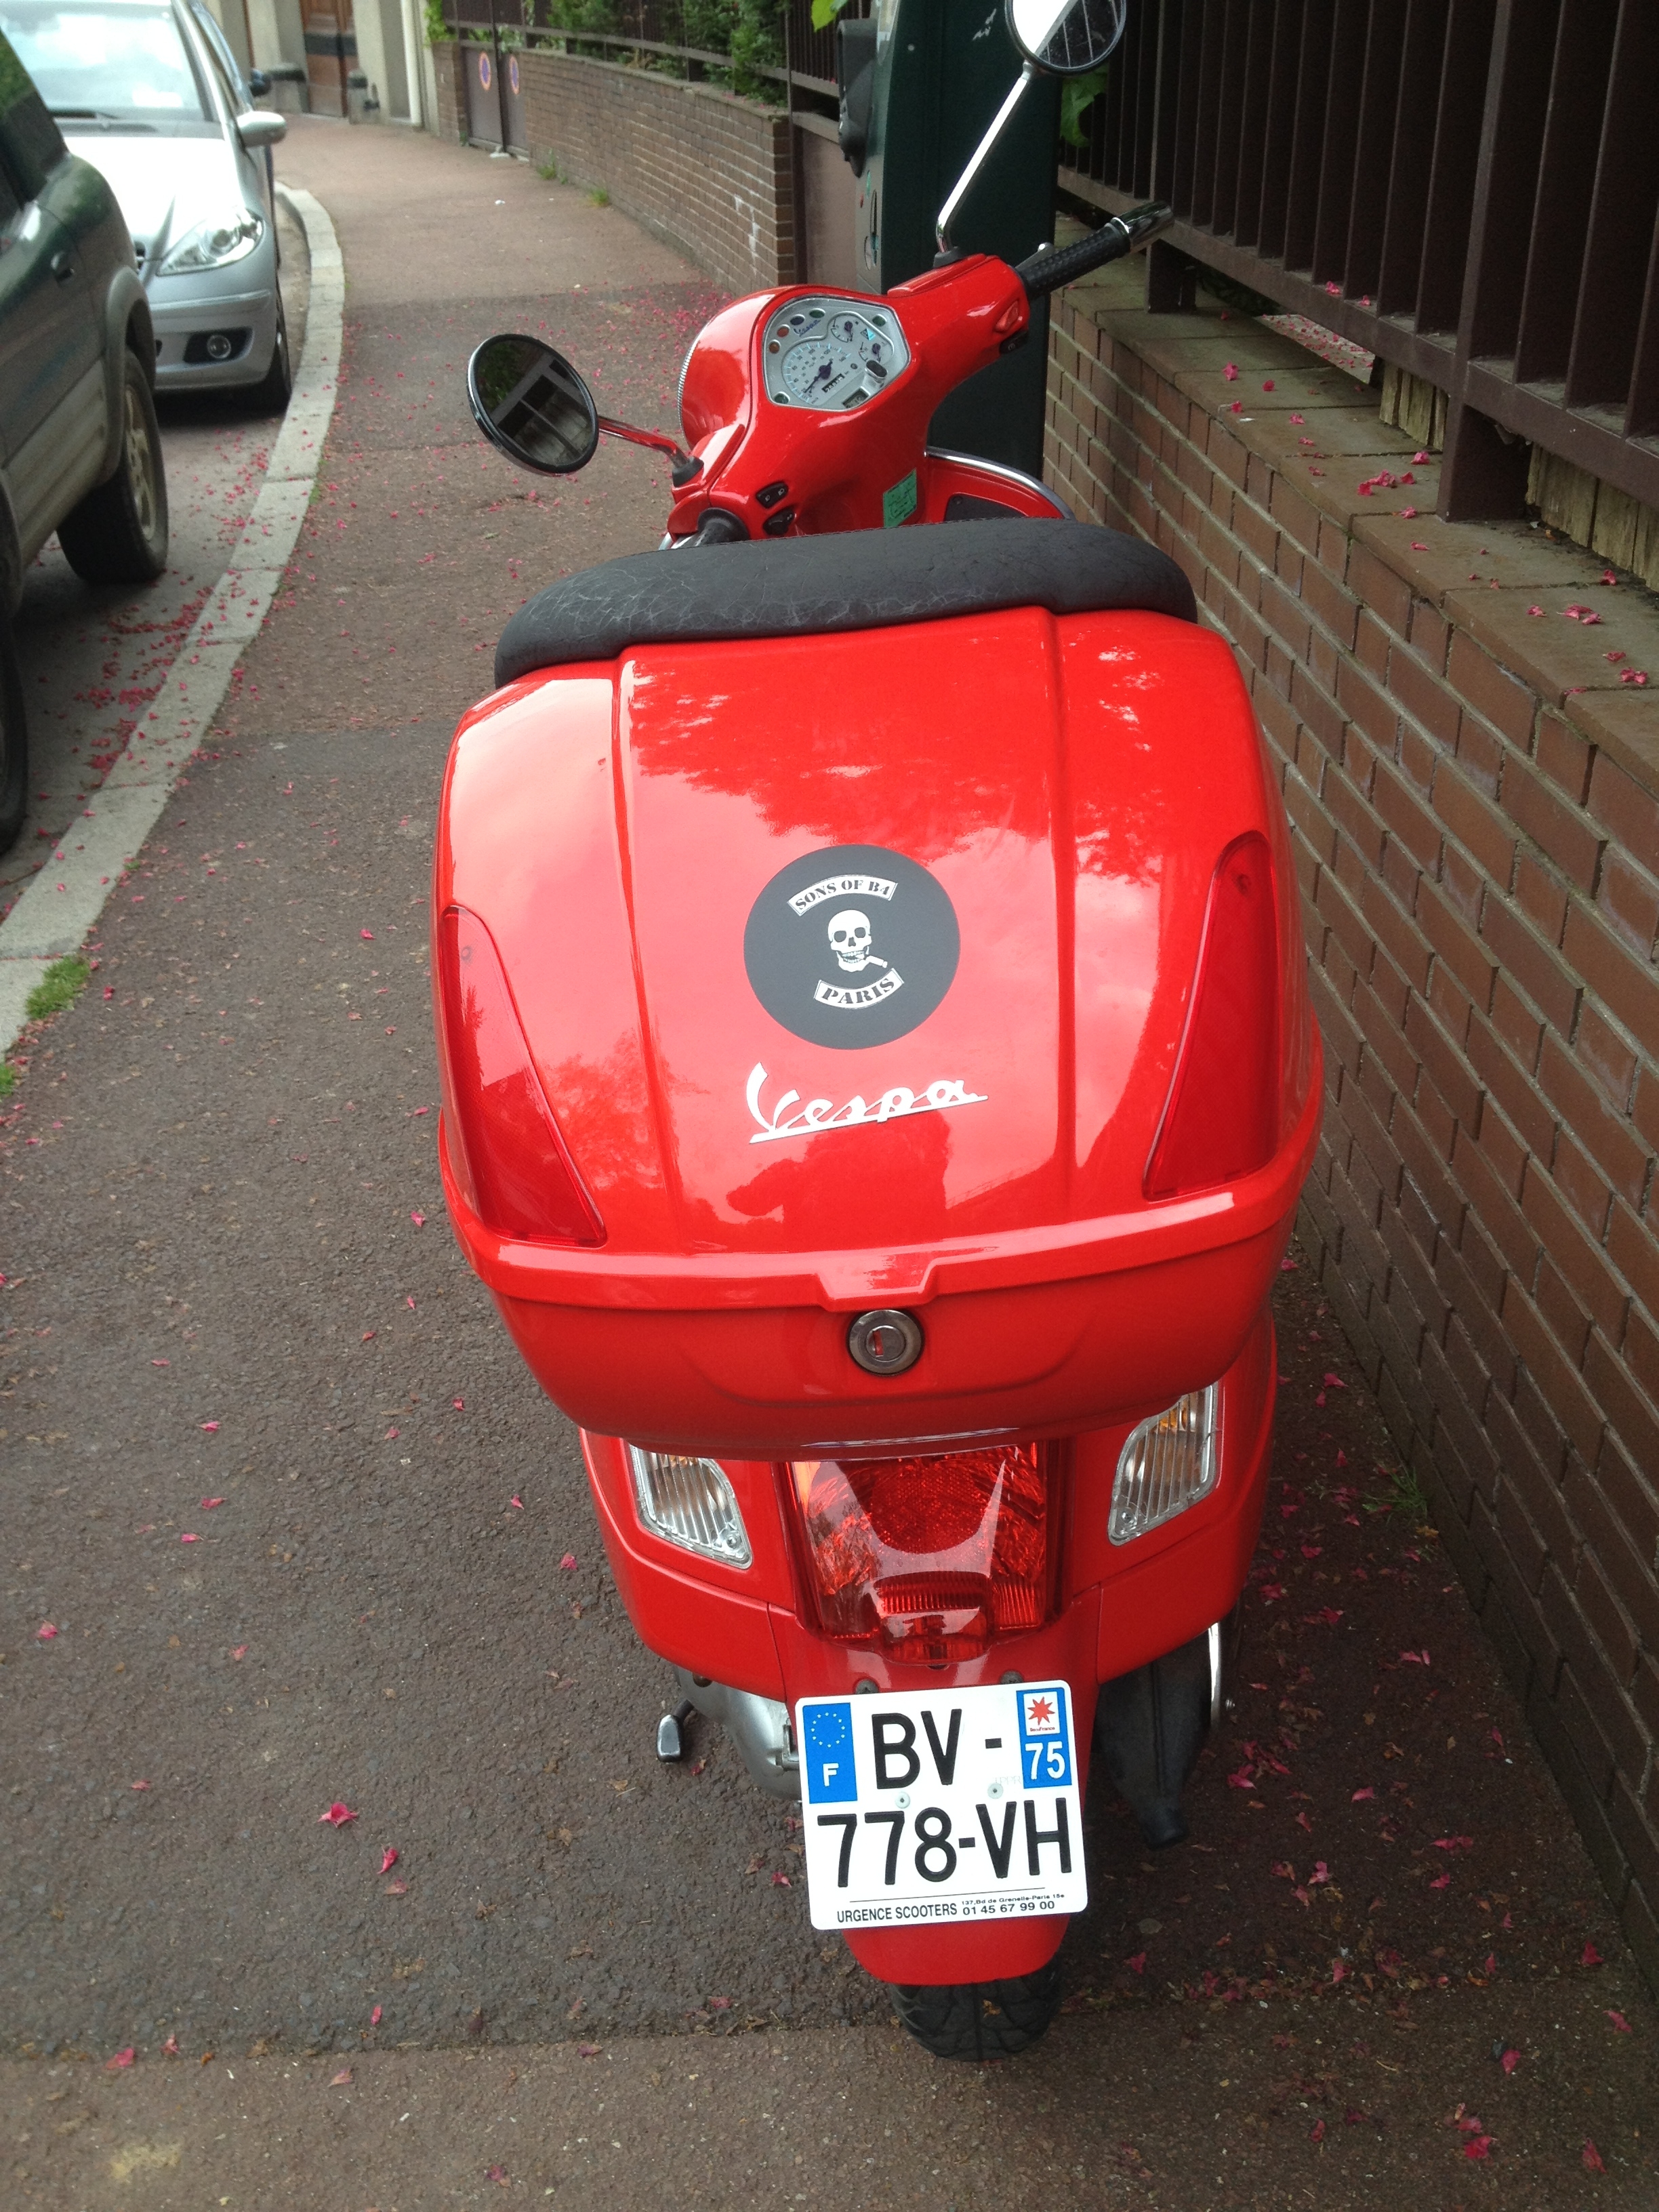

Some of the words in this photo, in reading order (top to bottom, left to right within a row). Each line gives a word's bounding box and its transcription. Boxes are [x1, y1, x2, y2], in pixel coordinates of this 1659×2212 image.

[795, 882, 837, 910] SONS
[841, 880, 863, 890] OF
[821, 977, 895, 1004] PARIS
[745, 1062, 989, 1144] Vespa
[1025, 1740, 1066, 1780] 75
[822, 1763, 839, 1787] F
[817, 1797, 1072, 1888] 778-VH
[837, 1907, 893, 1923] URGENCE
[895, 1903, 958, 1919] SCOOTERS
[962, 1906, 977, 1915] 01
[980, 1905, 996, 1914] 45
[1000, 1903, 1015, 1912] 67
[1020, 1902, 1036, 1911] 99
[1040, 1900, 1055, 1910] 00
